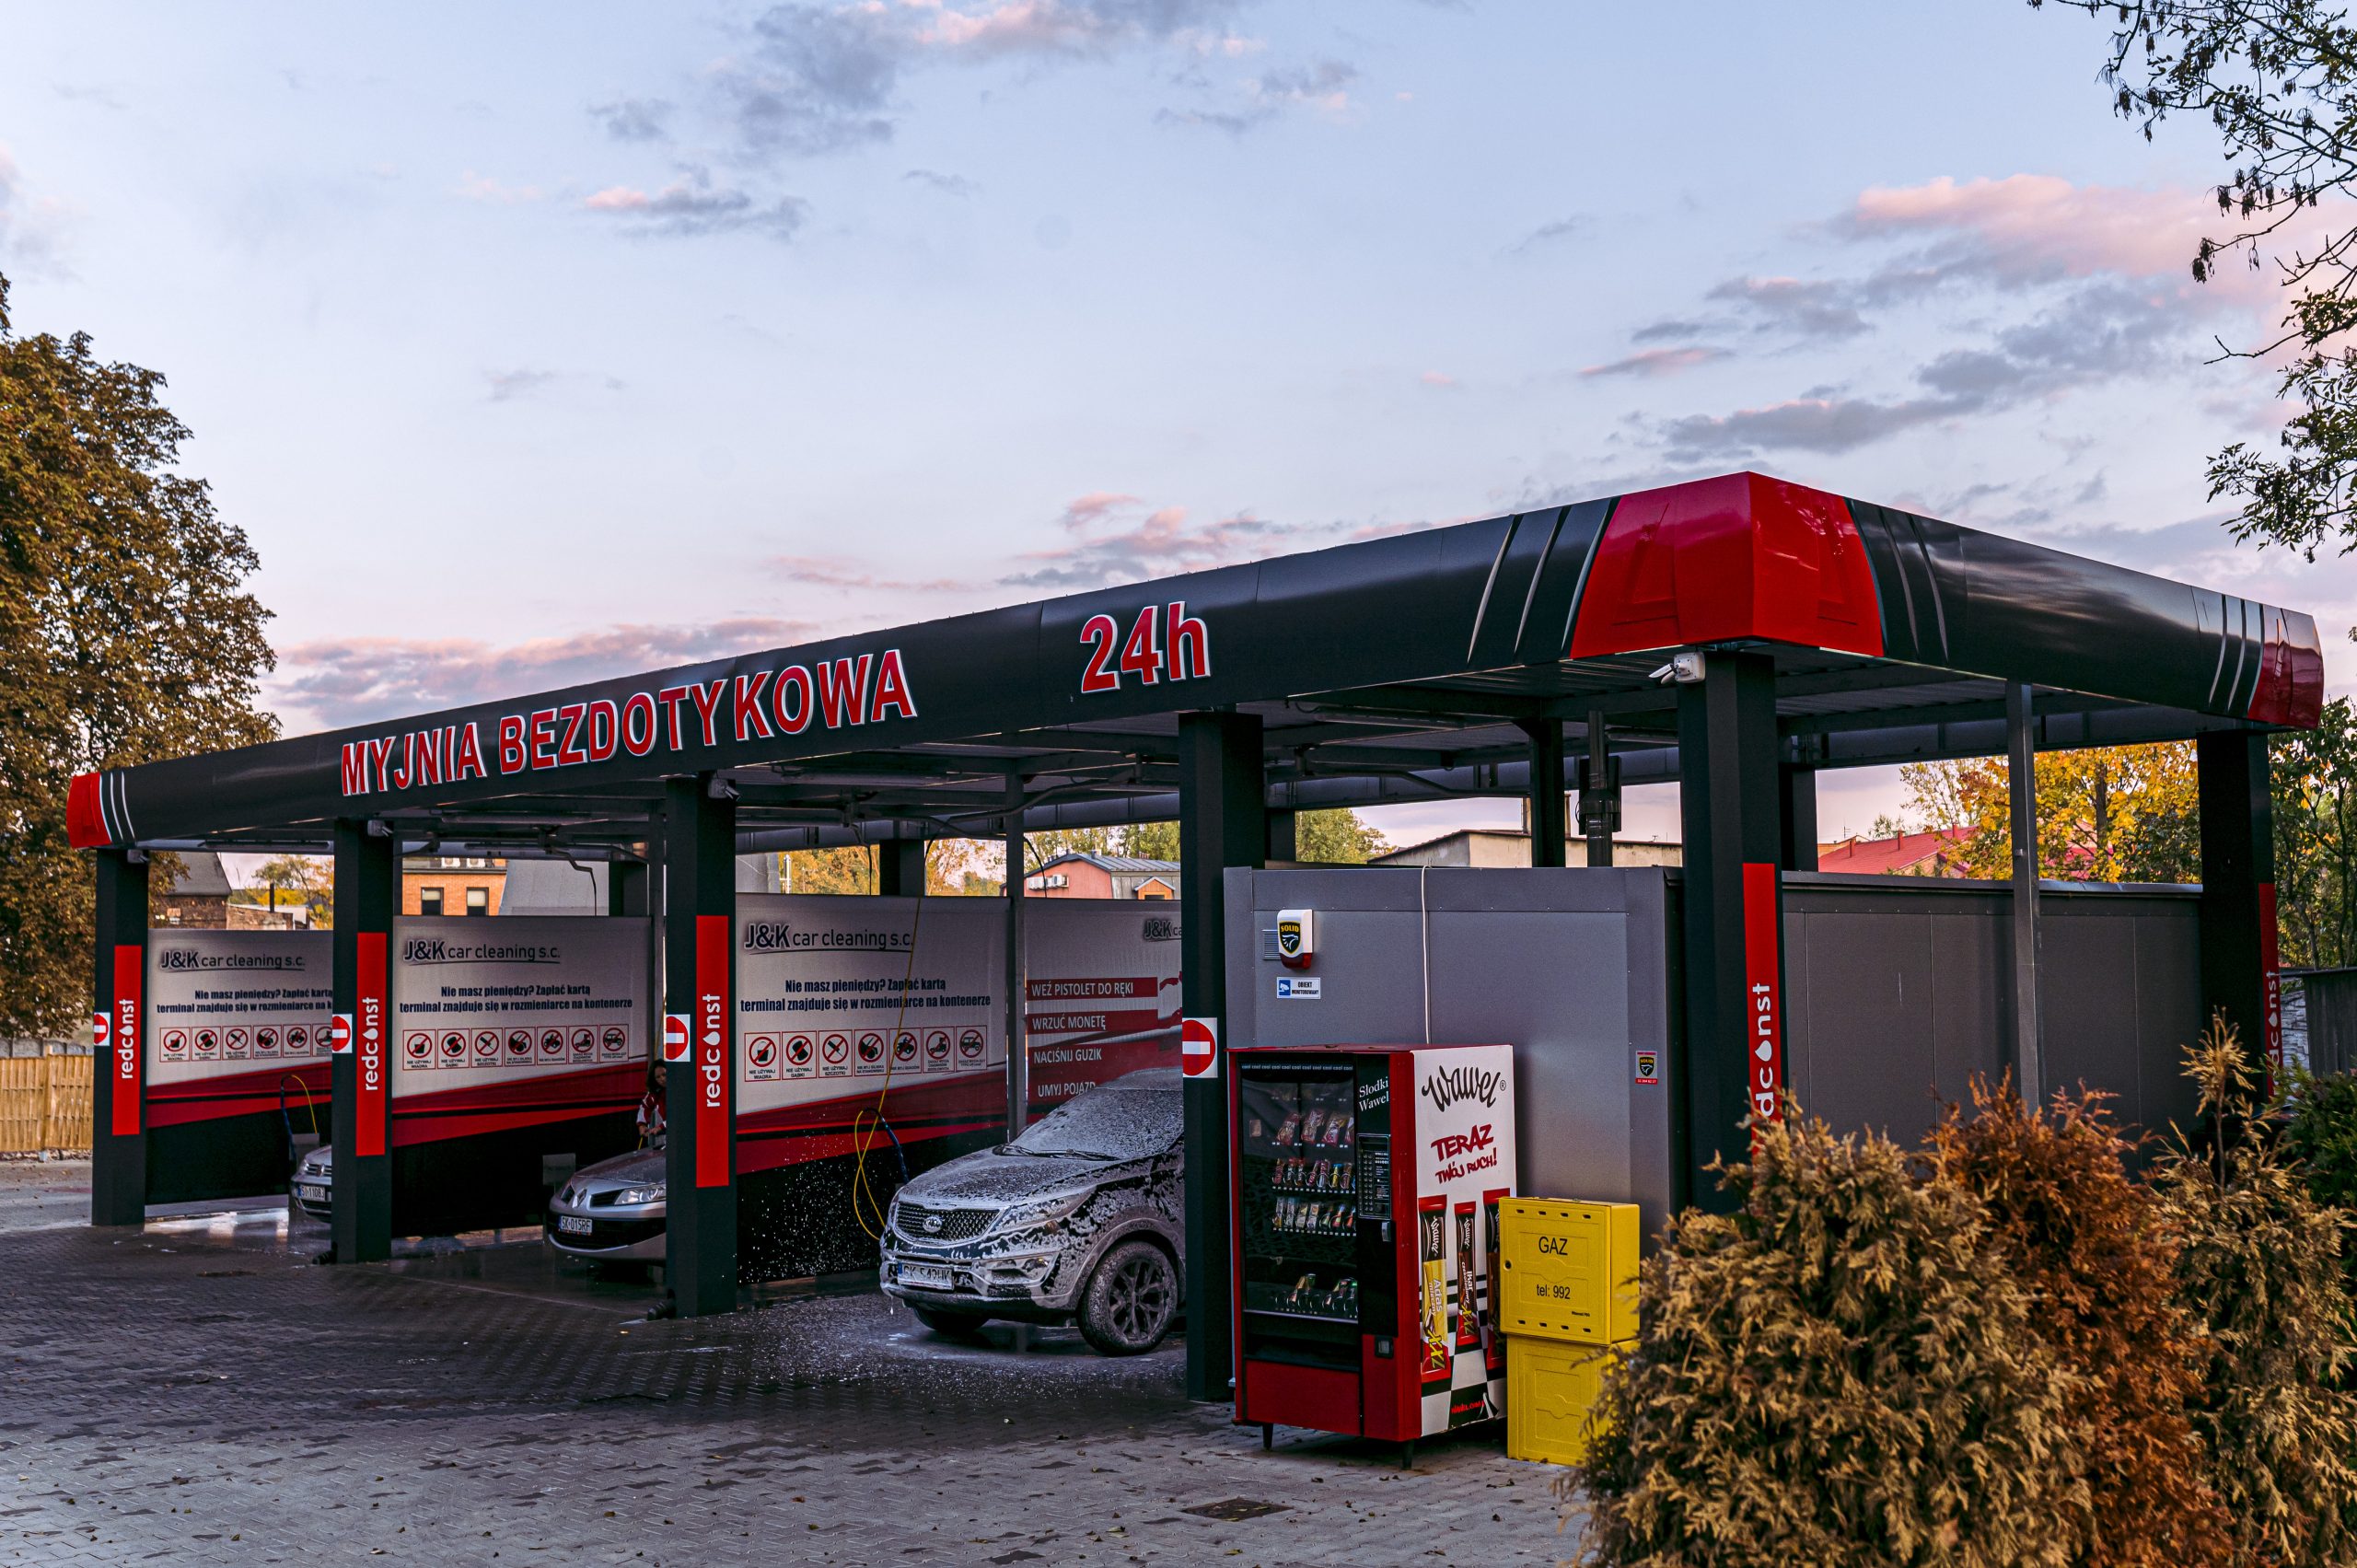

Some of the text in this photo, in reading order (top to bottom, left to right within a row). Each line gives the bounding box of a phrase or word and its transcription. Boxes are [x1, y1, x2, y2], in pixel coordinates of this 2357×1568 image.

[342, 600, 1211, 796] MYJNIA BEZDOTYKOWA 24h
[745, 923, 791, 948] J&K
[793, 932, 816, 946] car
[821, 929, 887, 949] cleaning
[1145, 920, 1172, 938] J&K
[161, 951, 306, 969] J&K car cleaning s.c.
[403, 941, 561, 961] J&K car cleaning s.c.
[194, 990, 210, 1000] Nie
[211, 991, 234, 1000] masz
[441, 986, 457, 997] Nie
[459, 986, 483, 997] masz
[484, 985, 534, 999] pieniędzy?
[785, 980, 802, 993] Nie
[804, 981, 830, 993] masz
[832, 979, 886, 994] pieniędzy?
[921, 978, 946, 992] kartą
[1031, 980, 1133, 998] WEŹ PISTOLET DO RĘKI
[157, 1002, 195, 1014] terminal
[196, 1002, 234, 1014] znajduje
[250, 1003, 257, 1012] w
[259, 1001, 314, 1011] rozmieniarce
[315, 1001, 326, 1010] na
[400, 998, 633, 1013] terminal znajduje się w rozmieniarce na kontenerze
[740, 994, 991, 1012] terminal znajduje się w rozmieniarce na kontenerze
[1032, 1014, 1107, 1030] WRZUĆ MONETĘ
[1034, 1048, 1103, 1064] NACIŚNIJ GUZIK
[1752, 982, 1775, 1118] dconst
[1038, 1082, 1062, 1098] UMYJ
[1422, 1065, 1501, 1112] Wawel
[1358, 1090, 1389, 1112] Wawel
[1431, 1123, 1494, 1162] TERAZ
[1434, 1147, 1498, 1184] TWÓJ RUCH!
[1538, 1236, 1568, 1256] GAZ
[1537, 1283, 1571, 1299] tel: 992
[1427, 1329, 1446, 1370] XXL
